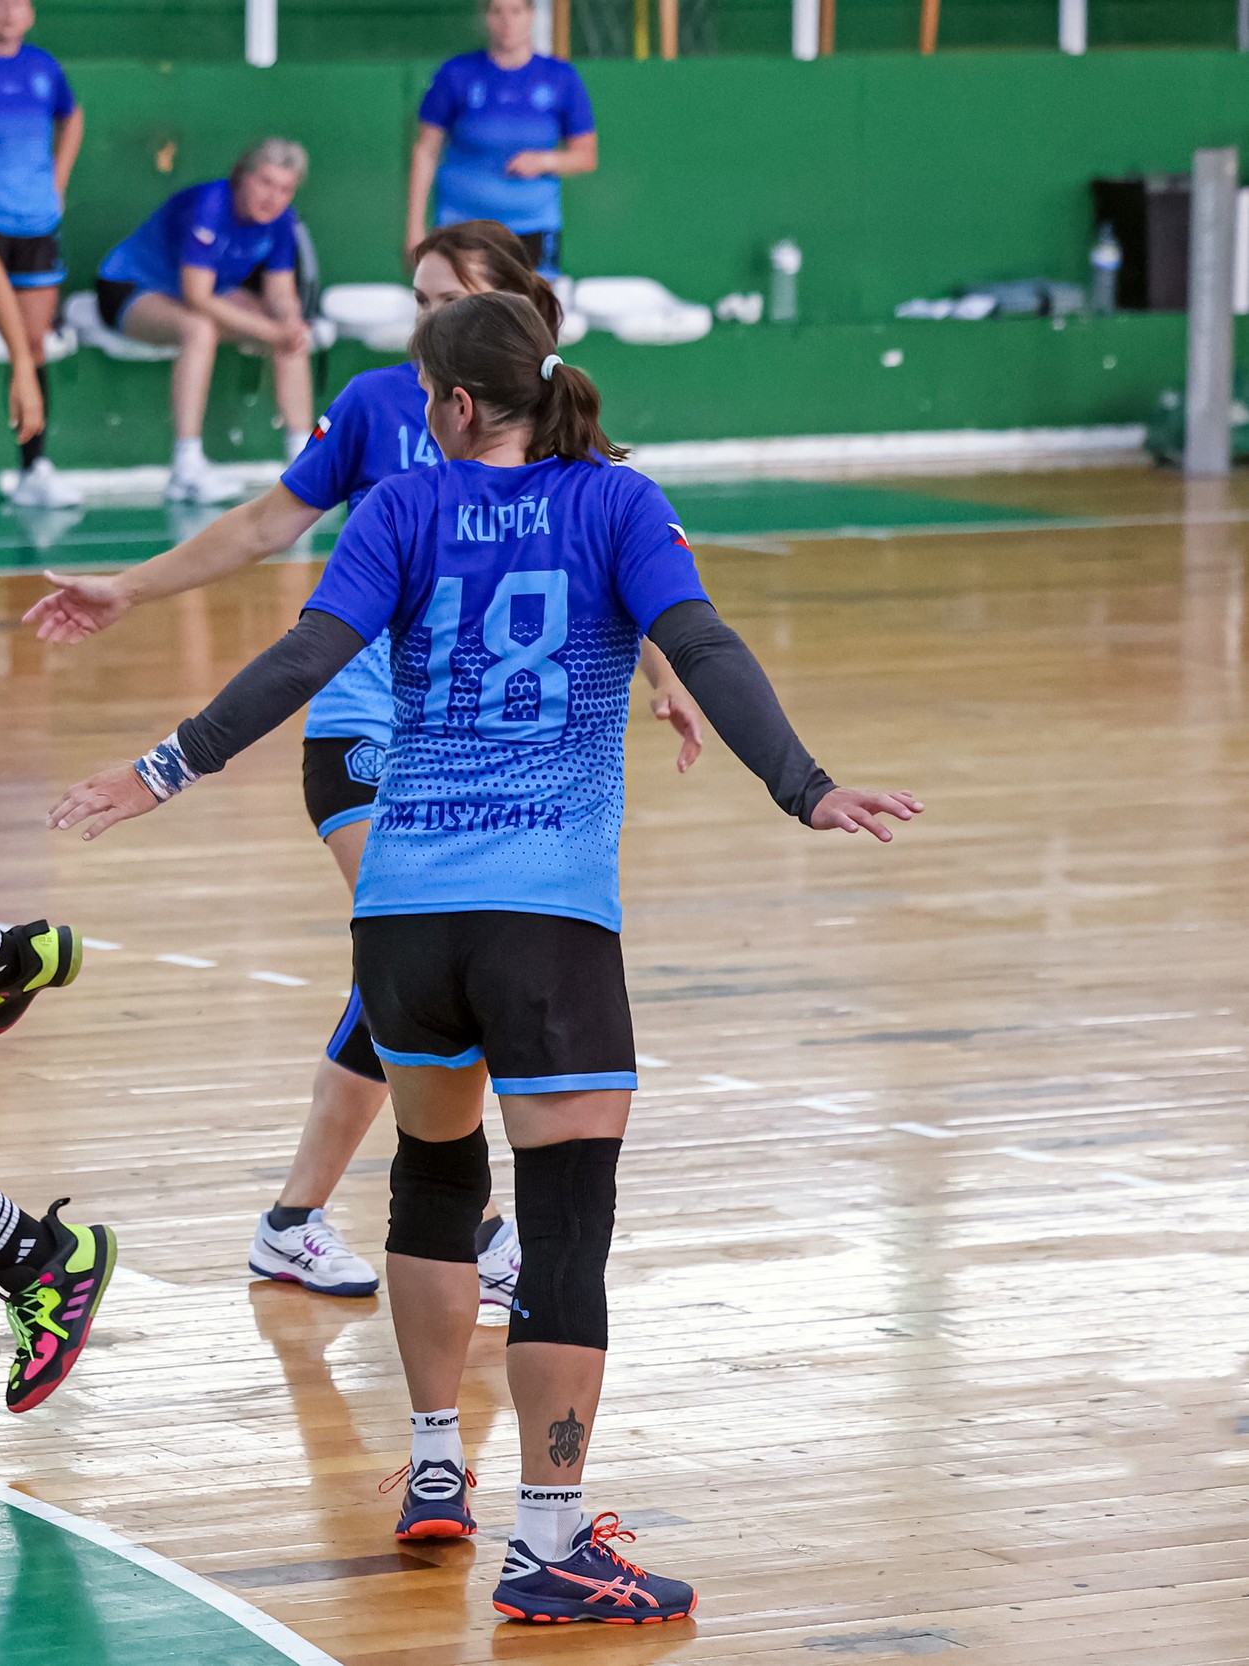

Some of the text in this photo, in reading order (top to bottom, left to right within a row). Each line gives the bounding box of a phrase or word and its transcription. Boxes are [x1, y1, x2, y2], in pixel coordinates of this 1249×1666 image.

[398, 425, 438, 470] 14
[456, 496, 550, 542] KUPČA
[422, 568, 569, 743] 18
[423, 801, 562, 831] OSTRAVA
